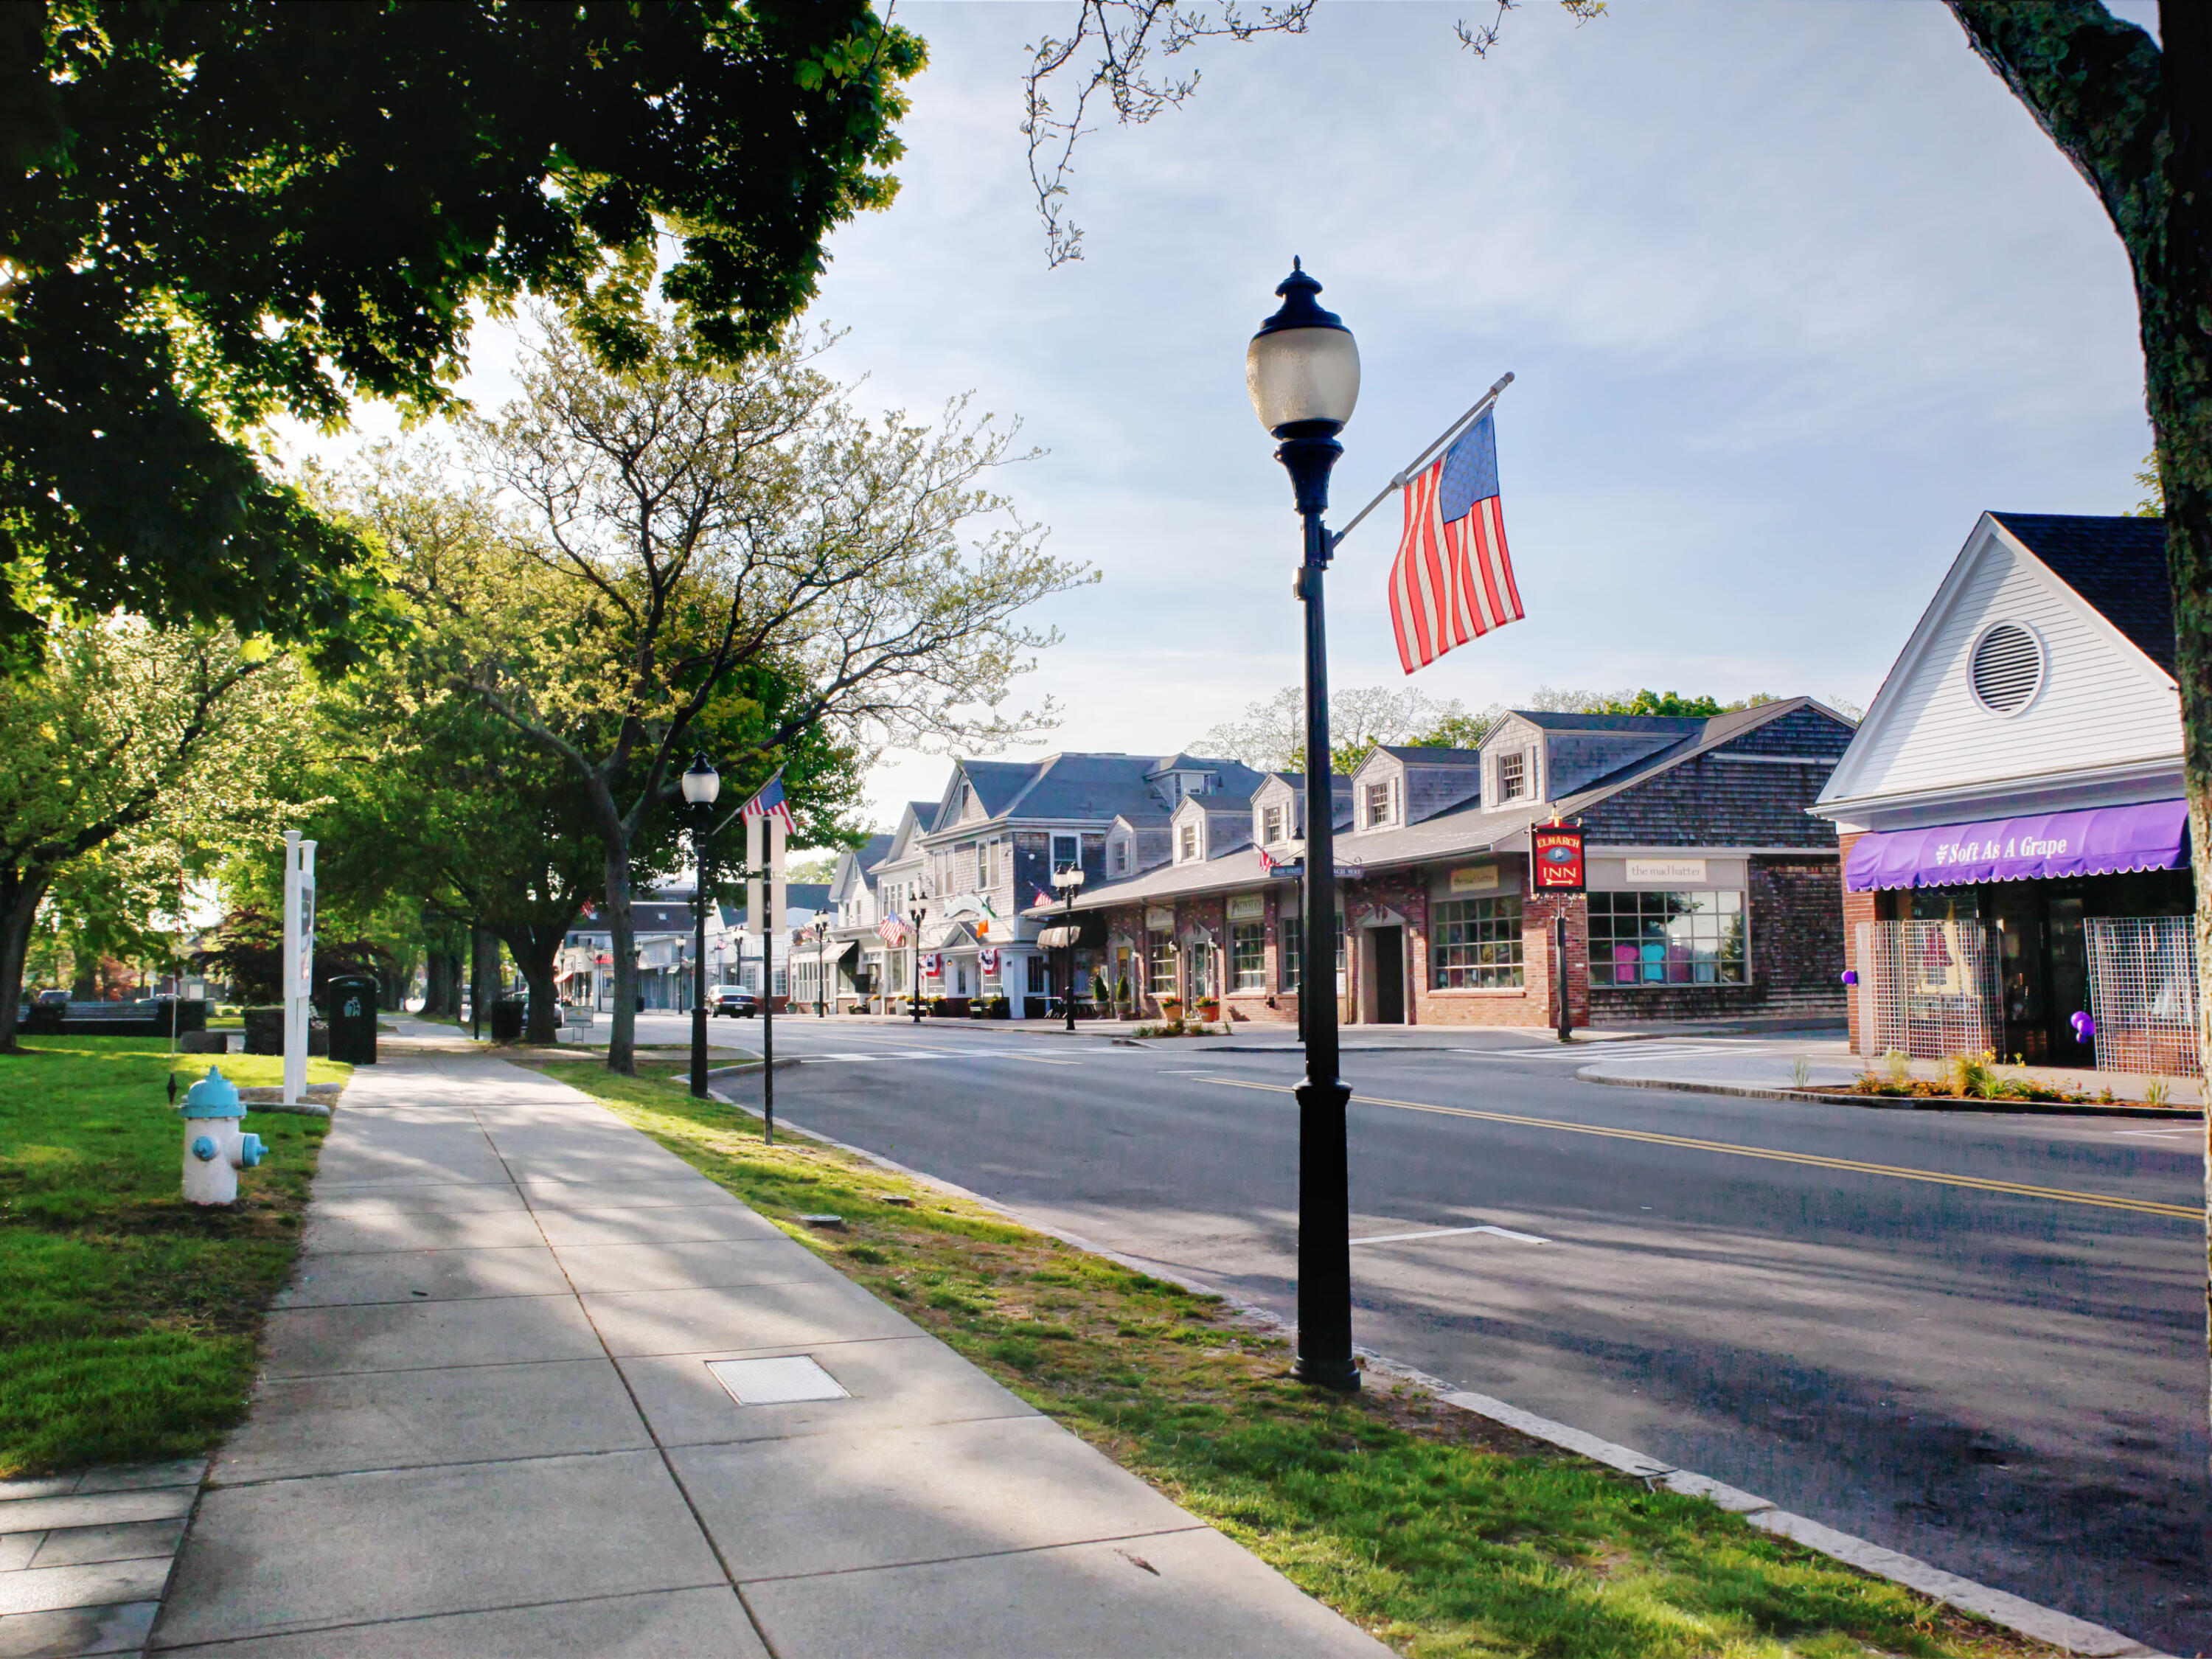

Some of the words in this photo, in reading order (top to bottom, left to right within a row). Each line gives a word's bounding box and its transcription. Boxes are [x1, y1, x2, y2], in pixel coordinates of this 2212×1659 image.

[1537, 835, 1579, 849] ELMARCH
[1948, 842, 1979, 864] Soft
[1981, 840, 2000, 860] As
[2003, 838, 2015, 858] A
[2020, 836, 2067, 860] Grape
[1543, 867, 1576, 878] INN
[1632, 864, 1648, 876] the
[1650, 864, 1670, 876] mad
[1672, 864, 1700, 876] hatter
